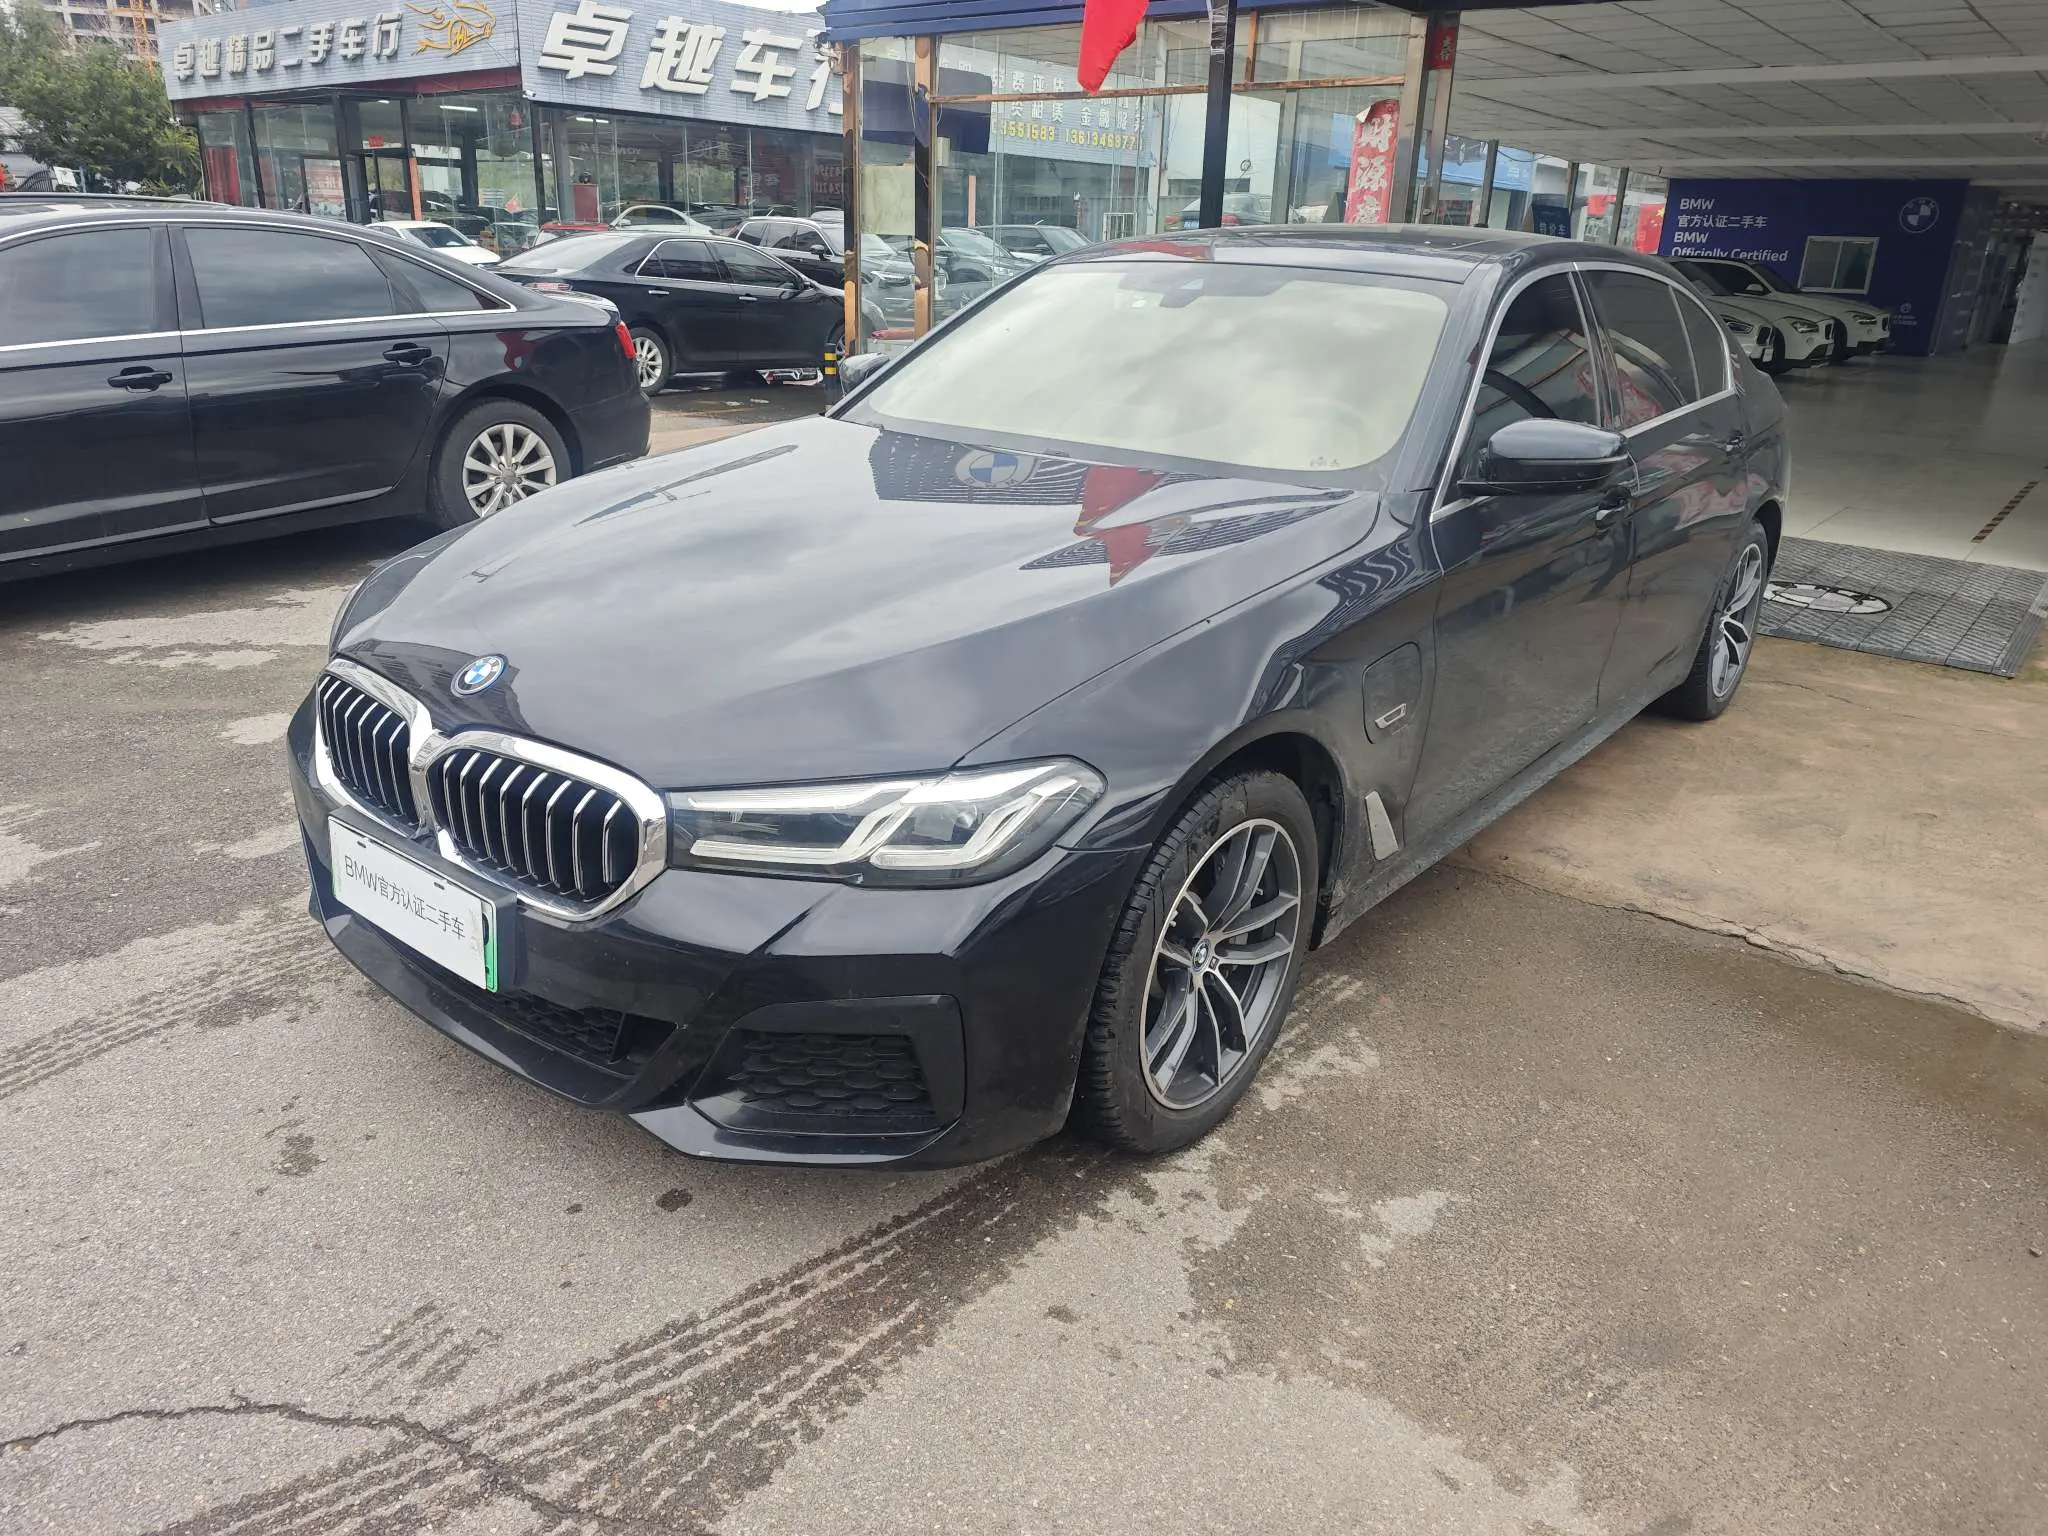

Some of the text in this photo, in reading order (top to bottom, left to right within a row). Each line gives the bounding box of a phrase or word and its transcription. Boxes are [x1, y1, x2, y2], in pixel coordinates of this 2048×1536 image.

[173, 13, 402, 81] 卓越精品二手车行
[1680, 199, 1715, 210] BMW
[1677, 214, 1768, 229] 官方认证二手车
[1674, 231, 1709, 243] BMW
[1731, 248, 1788, 261] Certified
[344, 855, 466, 940] BMW官方认证二手车
